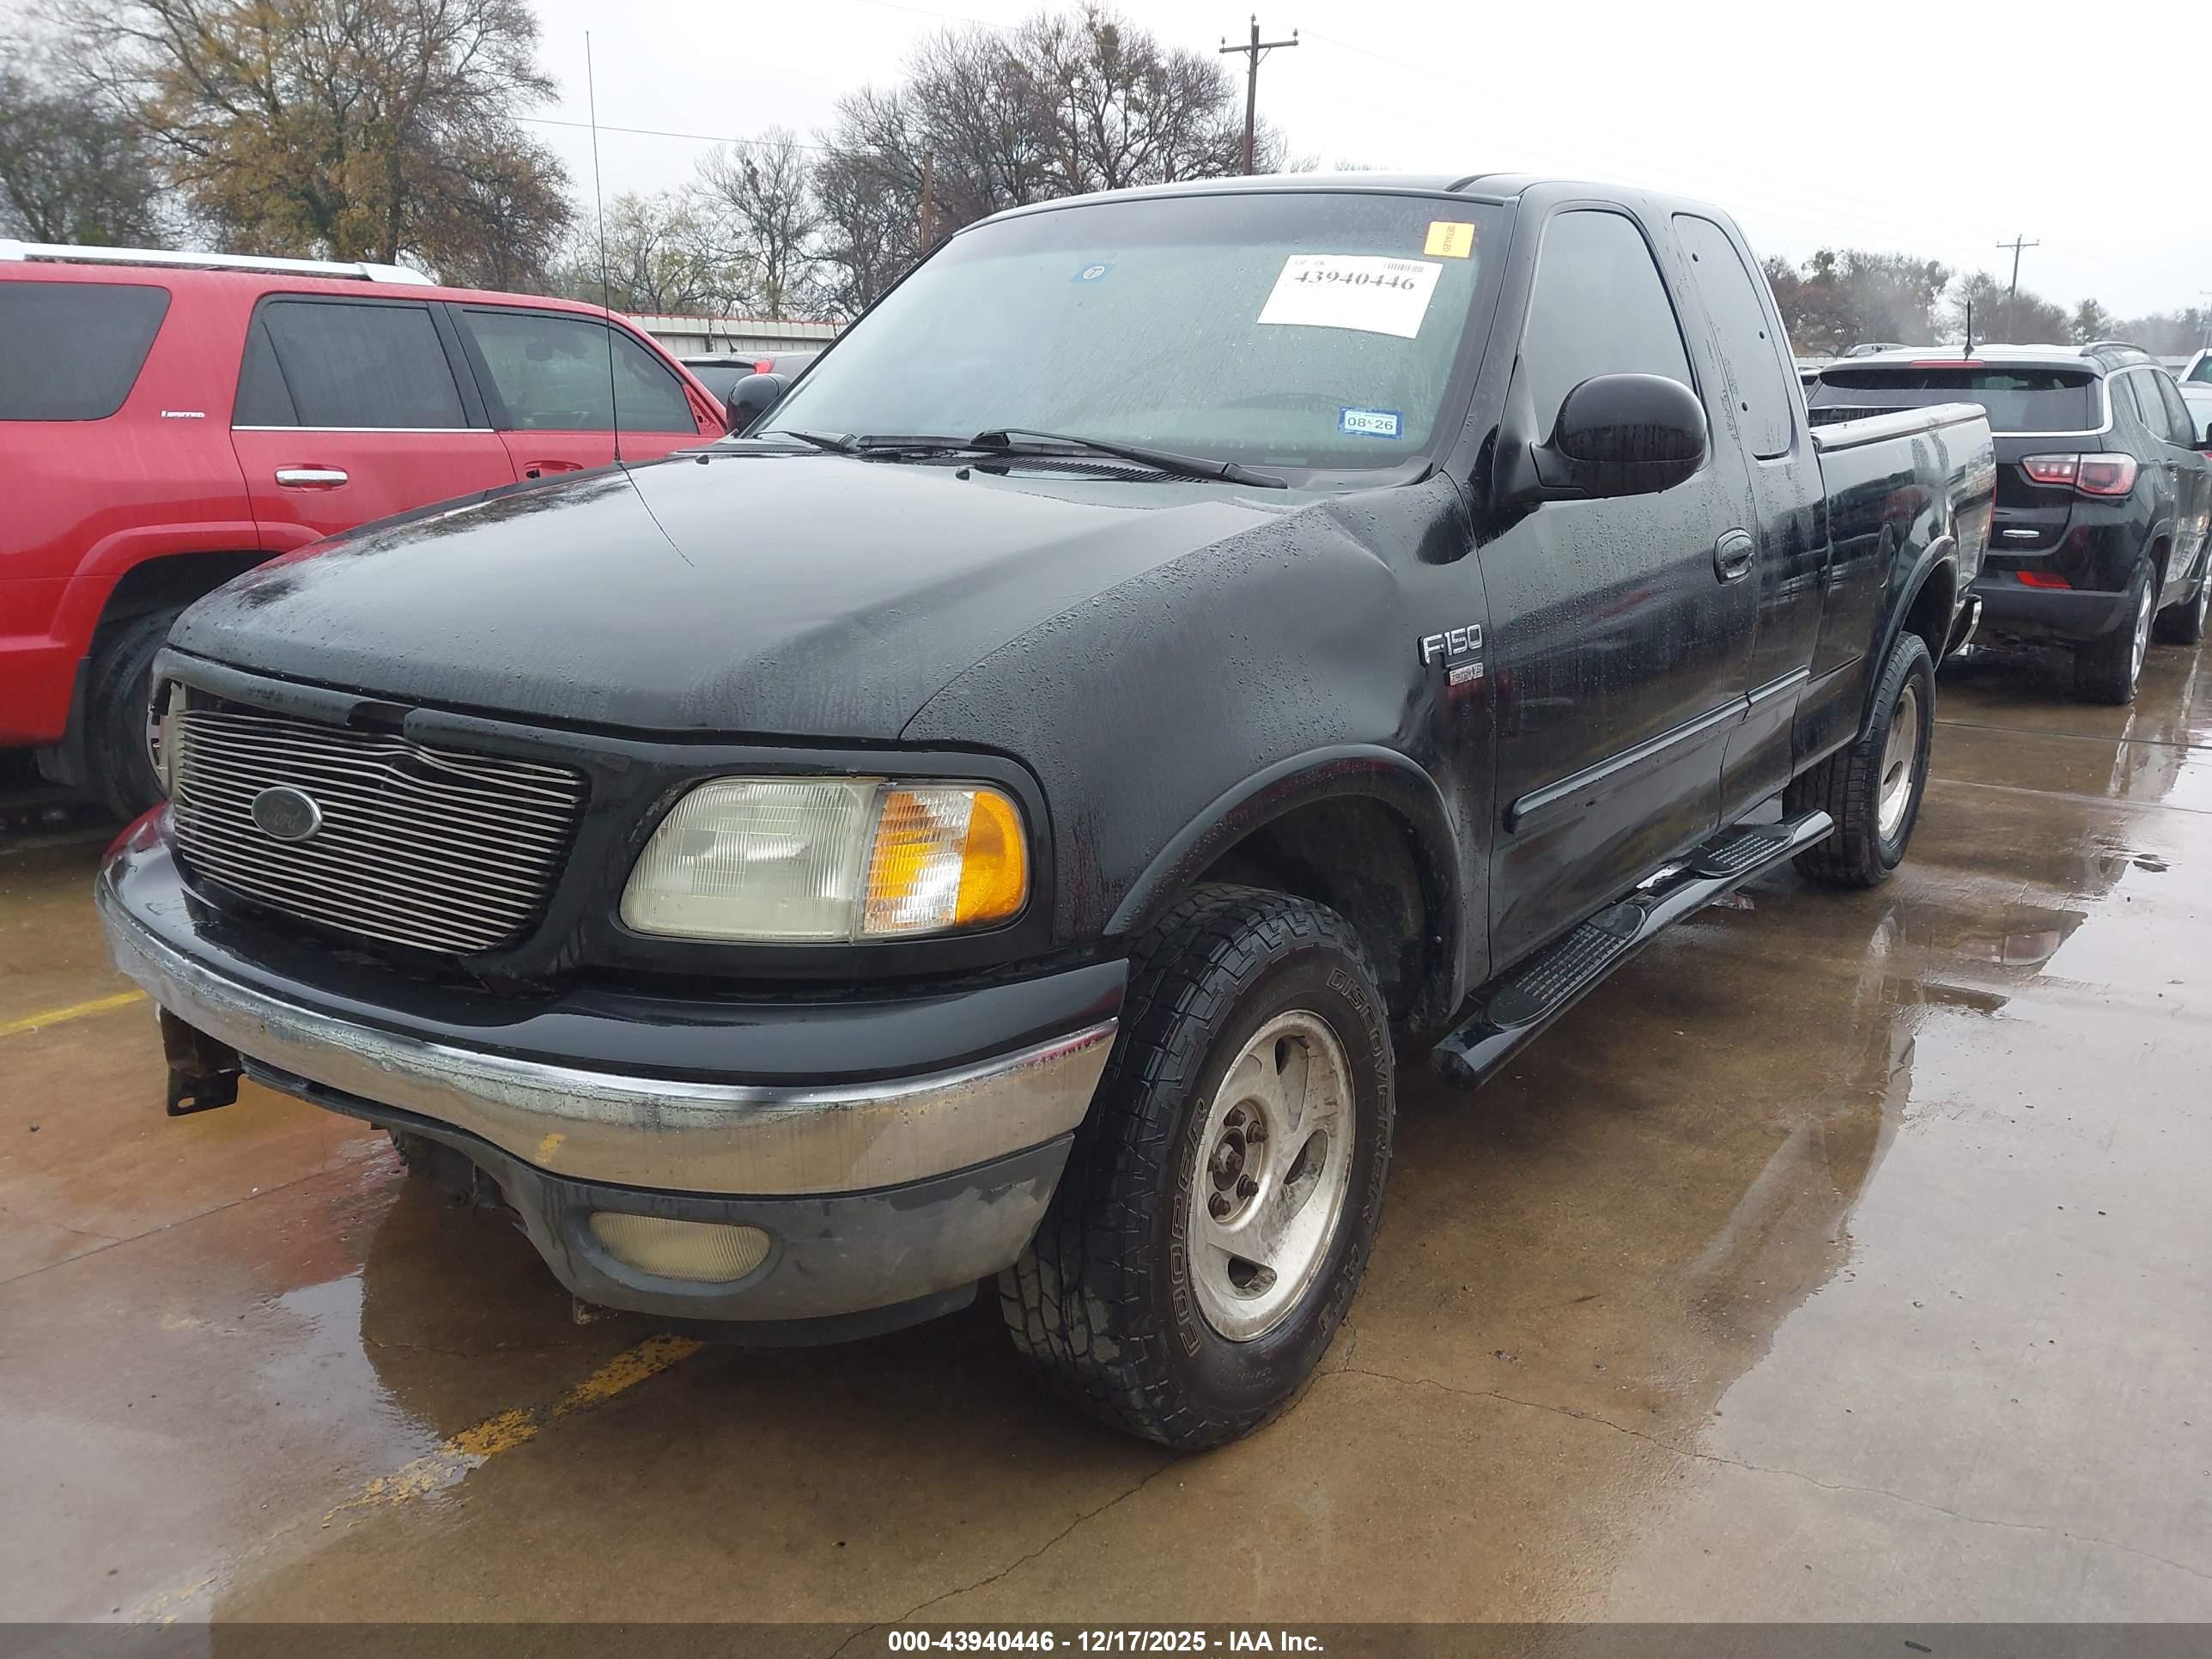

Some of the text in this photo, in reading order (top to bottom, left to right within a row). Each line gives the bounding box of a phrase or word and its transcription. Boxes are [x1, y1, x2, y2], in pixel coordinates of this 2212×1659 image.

[1294, 270, 1416, 290] 43940446
[1347, 417, 1393, 430] 08 26
[1169, 1096, 1208, 1358] COOPER
